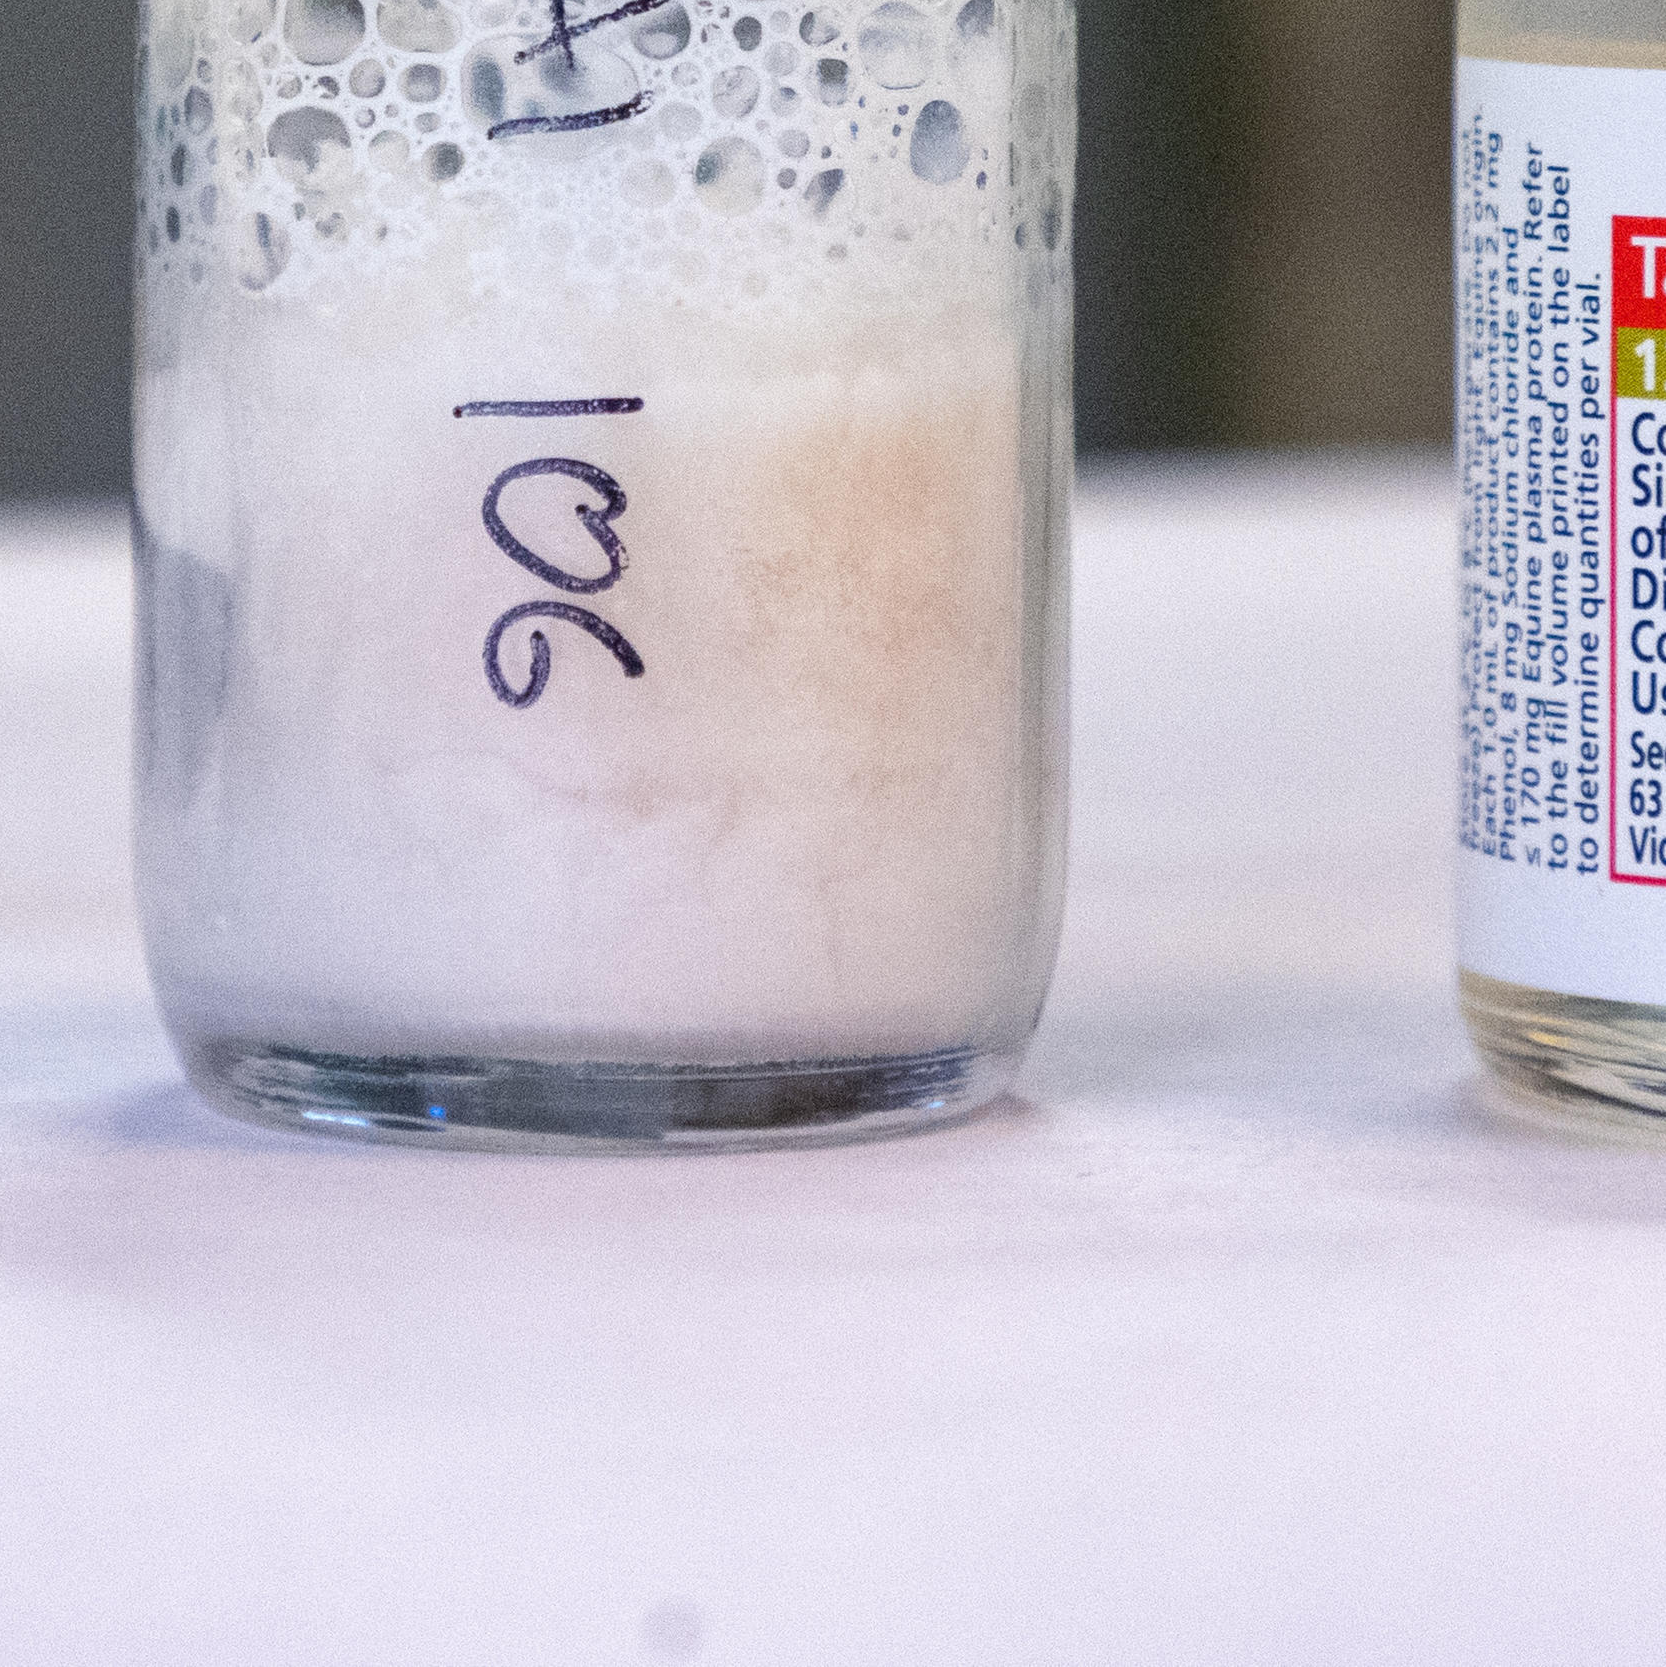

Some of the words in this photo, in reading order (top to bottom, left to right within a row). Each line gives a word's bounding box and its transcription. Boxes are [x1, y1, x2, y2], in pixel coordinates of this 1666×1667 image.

[1487, 132, 1502, 189] mg
[1523, 143, 1542, 240] Refer
[1486, 204, 1499, 255] 2.2
[1548, 165, 1569, 252] label
[1503, 227, 1518, 296] and
[1524, 255, 1546, 401] protein.
[1550, 268, 1569, 327] the
[1576, 273, 1600, 345] vial.
[1486, 270, 1499, 421] contains
[1552, 342, 1569, 387] on
[1503, 310, 1518, 457] chloride
[1579, 358, 1605, 420] per
[1522, 416, 1546, 543] plasma
[1547, 402, 1573, 537] printed
[1485, 435, 1500, 578] product
[1575, 433, 1605, 618] quantities
[1502, 472, 1518, 608] Sodium
[1484, 590, 1498, 628] of
[1522, 557, 1544, 683] Equine
[1547, 552, 1568, 686] volume
[1485, 642, 1498, 693] mL
[1504, 622, 1521, 678] mg
[1484, 707, 1497, 754] 1.0
[1501, 692, 1517, 713] 8
[1525, 698, 1544, 753] mg
[1544, 701, 1567, 745] fill
[1574, 632, 1598, 823] determine
[1483, 775, 1497, 857] Each
[1499, 728, 1518, 862] Phenol,
[1521, 767, 1540, 827] 170
[1546, 761, 1567, 820] the
[1629, 779, 1662, 818] 63
[1548, 834, 1567, 868] to
[1577, 838, 1598, 874] to
